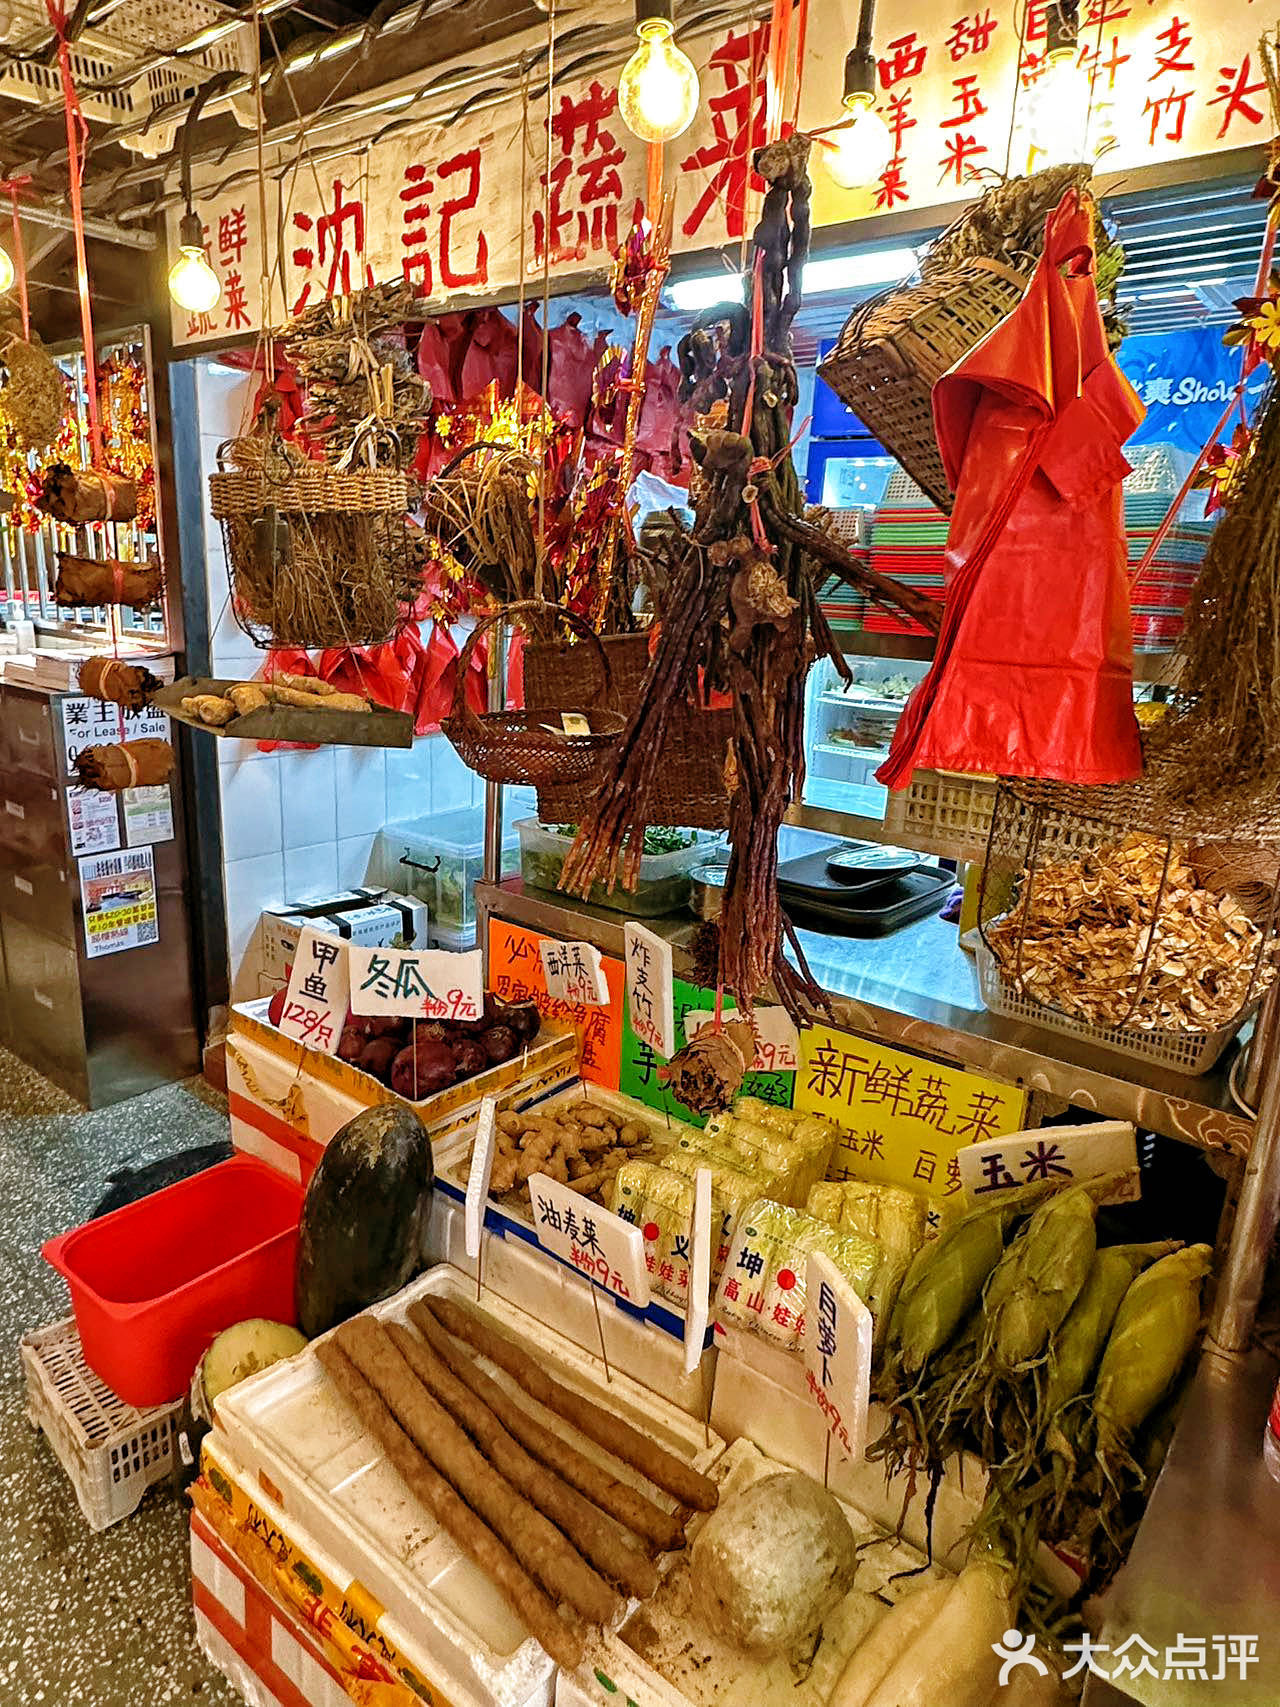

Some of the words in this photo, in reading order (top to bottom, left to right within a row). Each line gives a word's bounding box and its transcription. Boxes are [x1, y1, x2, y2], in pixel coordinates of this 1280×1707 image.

[938, 8, 999, 186] 甜玉米
[94, 726, 130, 738] Lease
[140, 722, 165, 734] Sale
[298, 939, 340, 1004] 甲鱼
[359, 953, 437, 999] 冬瓜
[629, 937, 654, 1020] 炸支竹
[282, 1000, 334, 1050] 128/只
[973, 1140, 1074, 1194] 玉米
[537, 1194, 607, 1259] 油麦菜
[736, 1246, 765, 1279] 坤
